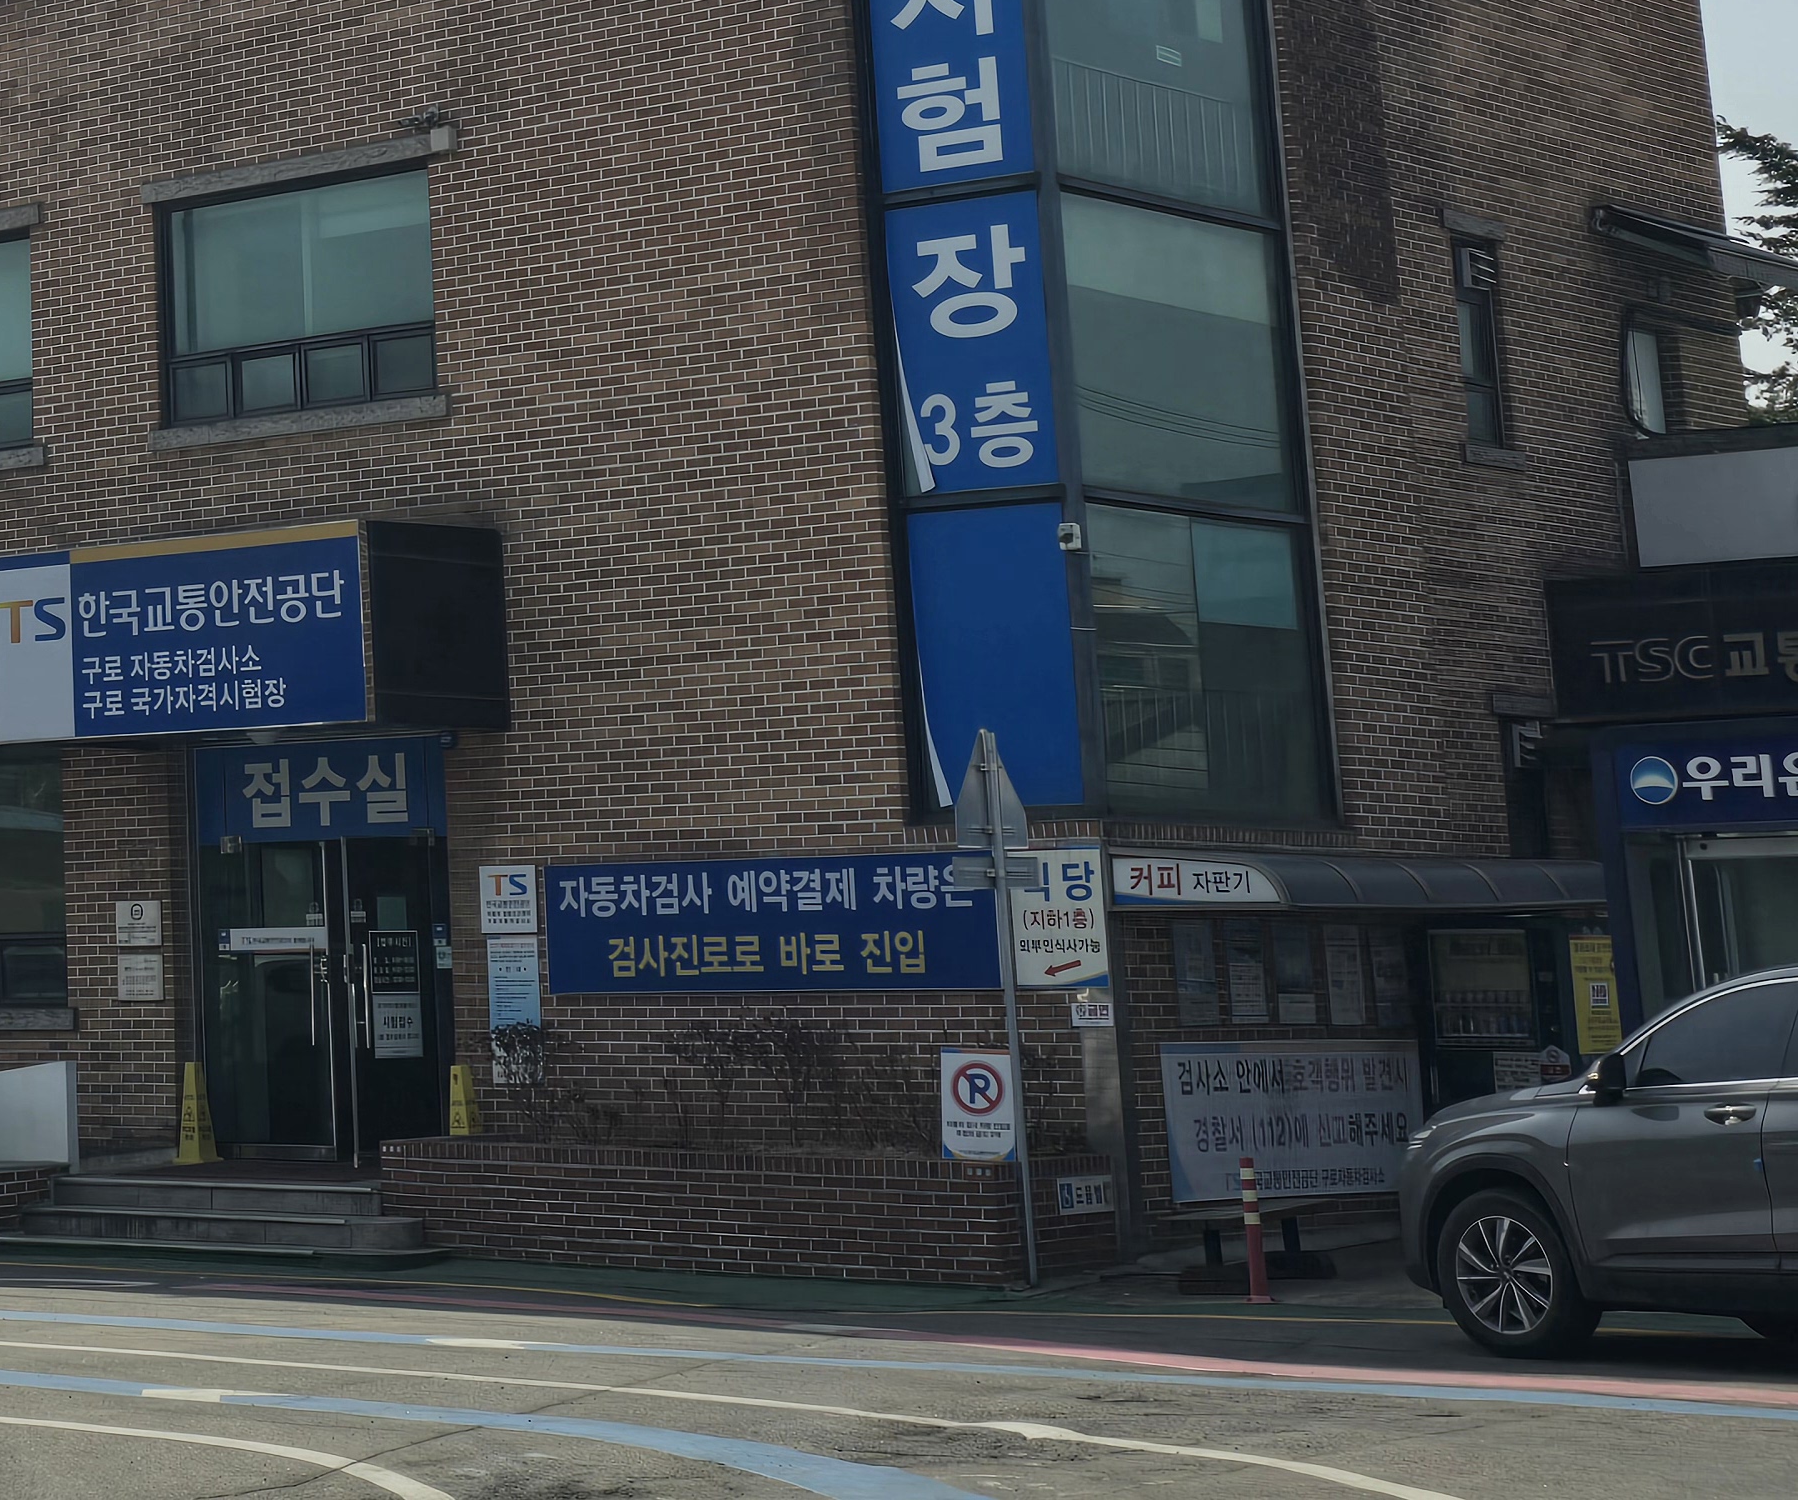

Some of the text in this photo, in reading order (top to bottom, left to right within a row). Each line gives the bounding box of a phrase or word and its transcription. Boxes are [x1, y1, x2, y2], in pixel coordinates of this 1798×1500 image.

[916, 380, 1039, 469] 3층
[77, 569, 346, 639] 한국교통안전공단
[81, 644, 263, 685] 구로 자동차검사소
[1590, 635, 1714, 684] TSC
[82, 677, 288, 720] 구로 국가자격시험장
[241, 752, 410, 828] 접수실
[487, 873, 528, 896] TS
[558, 863, 974, 918] 자동차검사 예약결제 차량은
[1130, 863, 1252, 896] 커피 자판기
[1022, 908, 1095, 931] (지하1층)
[607, 930, 927, 978] 검사진로로 바로 진입
[1177, 1059, 1229, 1096] 검사소
[1236, 1057, 1285, 1094] 안에서
[1193, 1115, 1244, 1153] 경찰서
